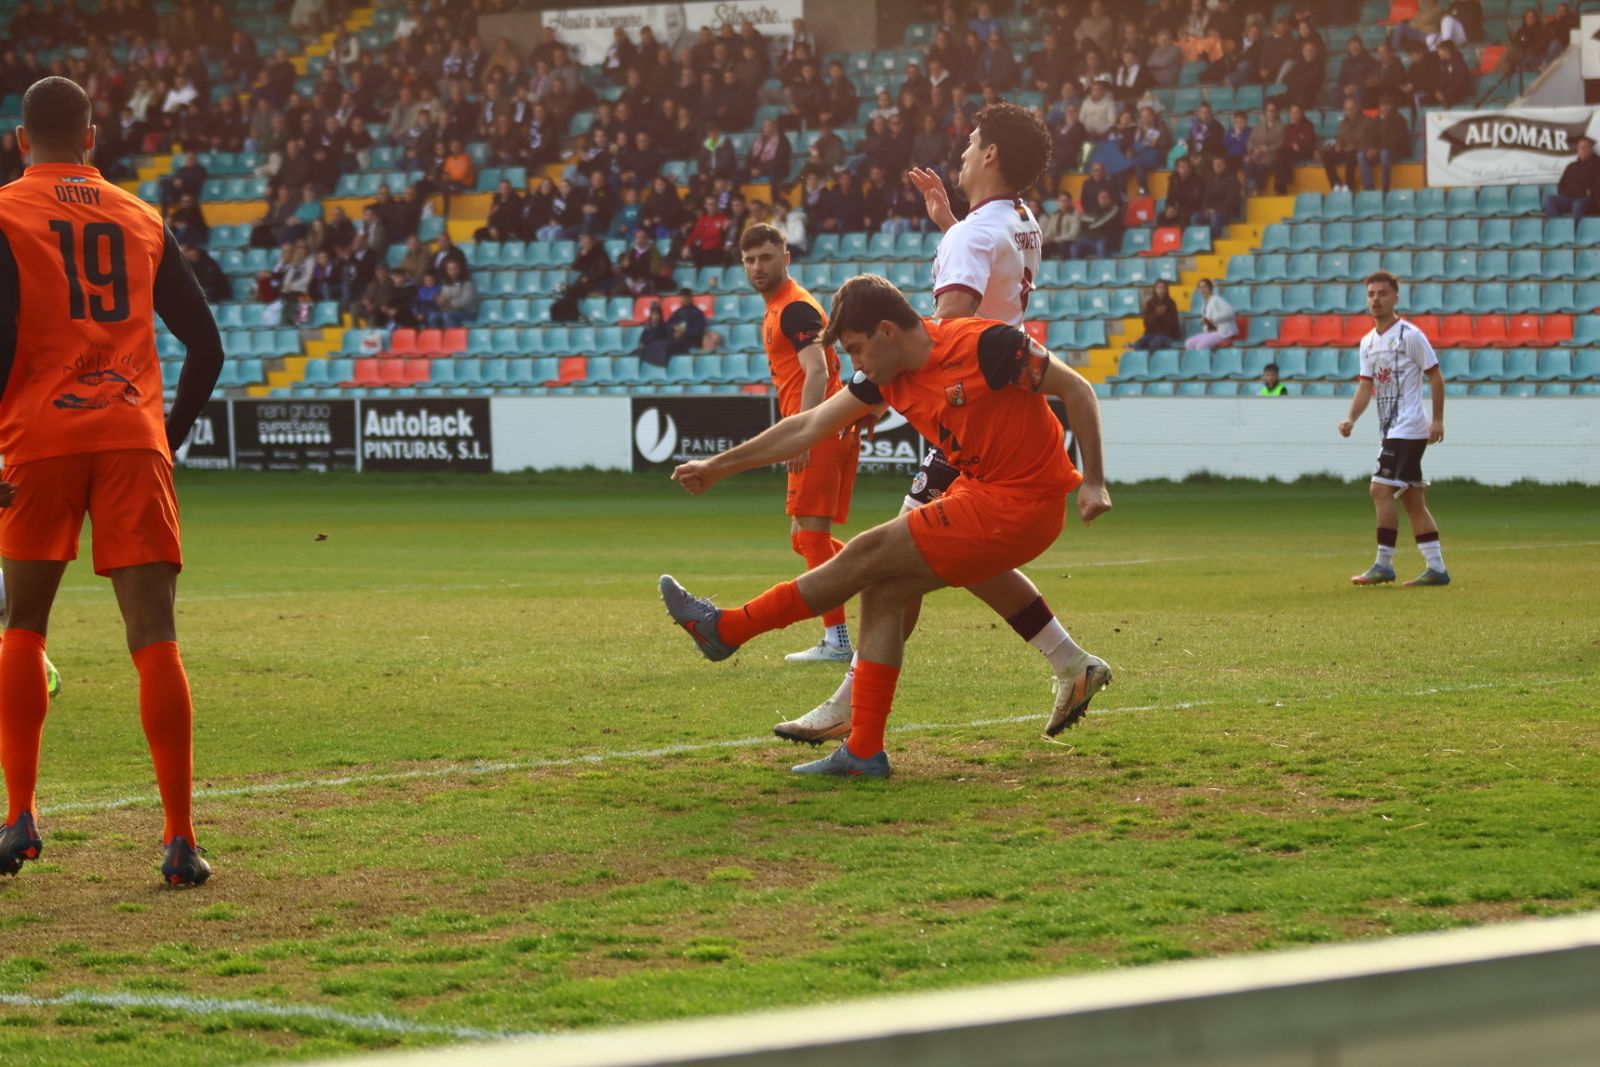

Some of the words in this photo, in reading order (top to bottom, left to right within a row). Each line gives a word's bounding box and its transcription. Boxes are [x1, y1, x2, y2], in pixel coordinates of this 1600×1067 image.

[1465, 121, 1570, 151] ALJOMAR
[54, 185, 100, 206] DEIBY
[48, 219, 130, 323] 19
[364, 408, 474, 437] Autolack
[364, 441, 453, 462] PINTURAS,
[457, 441, 489, 459] S.L.
